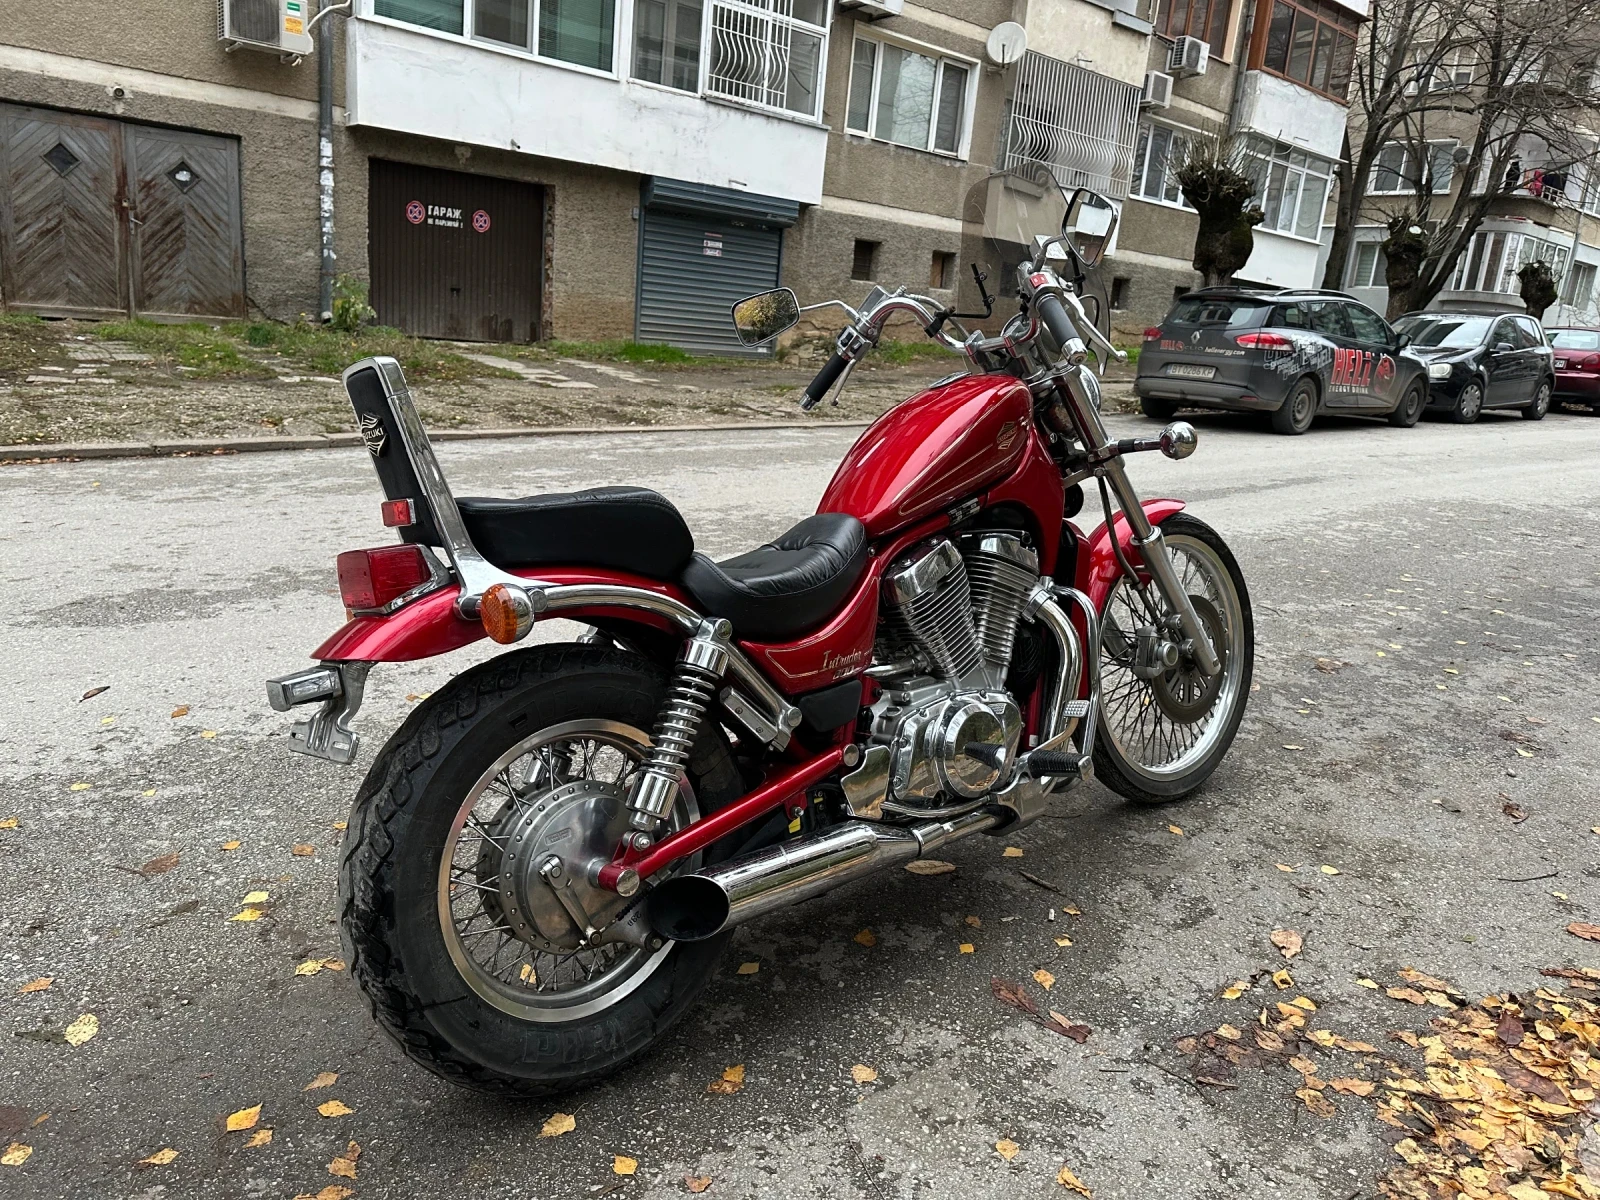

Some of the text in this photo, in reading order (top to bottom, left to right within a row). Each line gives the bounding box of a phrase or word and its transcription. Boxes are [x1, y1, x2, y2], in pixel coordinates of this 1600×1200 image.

[427, 205, 462, 219] ГАРАЖ
[1204, 346, 1245, 356] hellenergy.com
[1330, 348, 1372, 387] HELL
[1328, 385, 1369, 394] ENERGY DRINK
